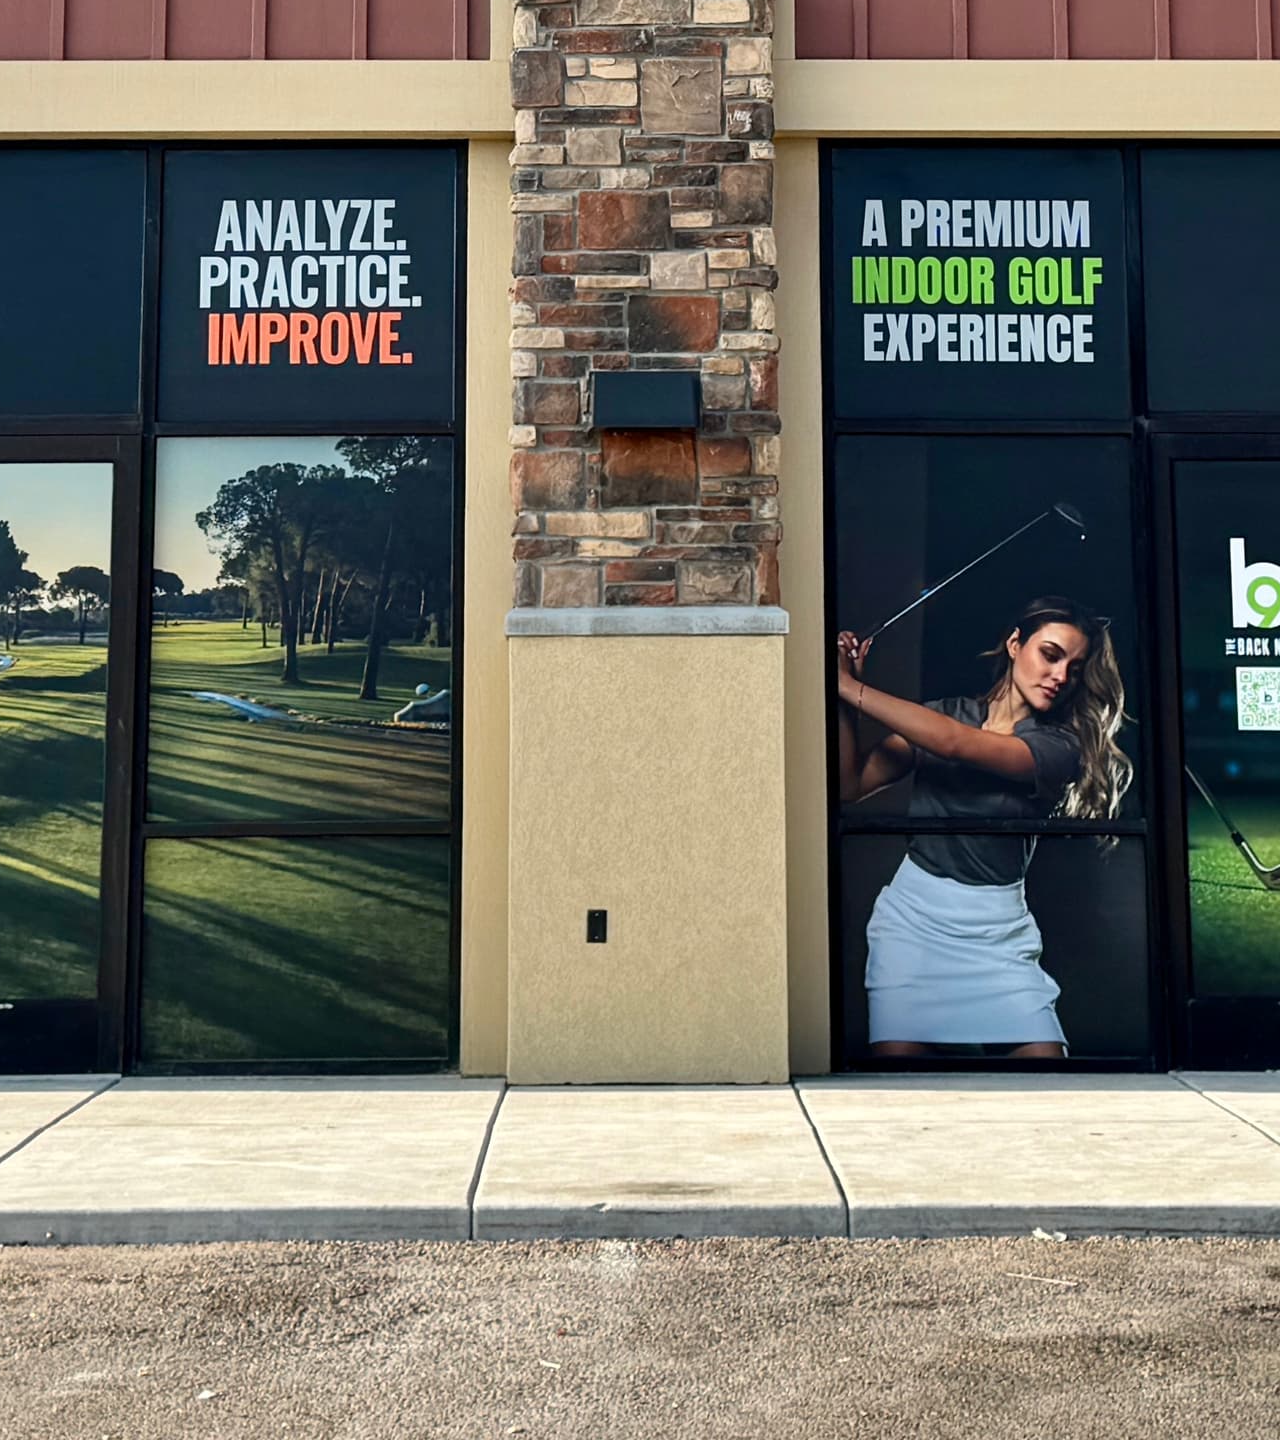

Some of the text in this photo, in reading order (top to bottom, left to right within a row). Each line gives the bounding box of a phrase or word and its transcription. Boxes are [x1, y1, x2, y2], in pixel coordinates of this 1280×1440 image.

[214, 199, 407, 251] ANALYZE.
[862, 199, 1091, 248] A PREMIUM
[199, 255, 422, 309] PRACTICE.
[852, 256, 1104, 305] INDOOR GOLF
[207, 311, 414, 366] IMPROVE.
[863, 313, 1095, 363] EXPERIENCE
[1237, 637, 1270, 656] BACK
